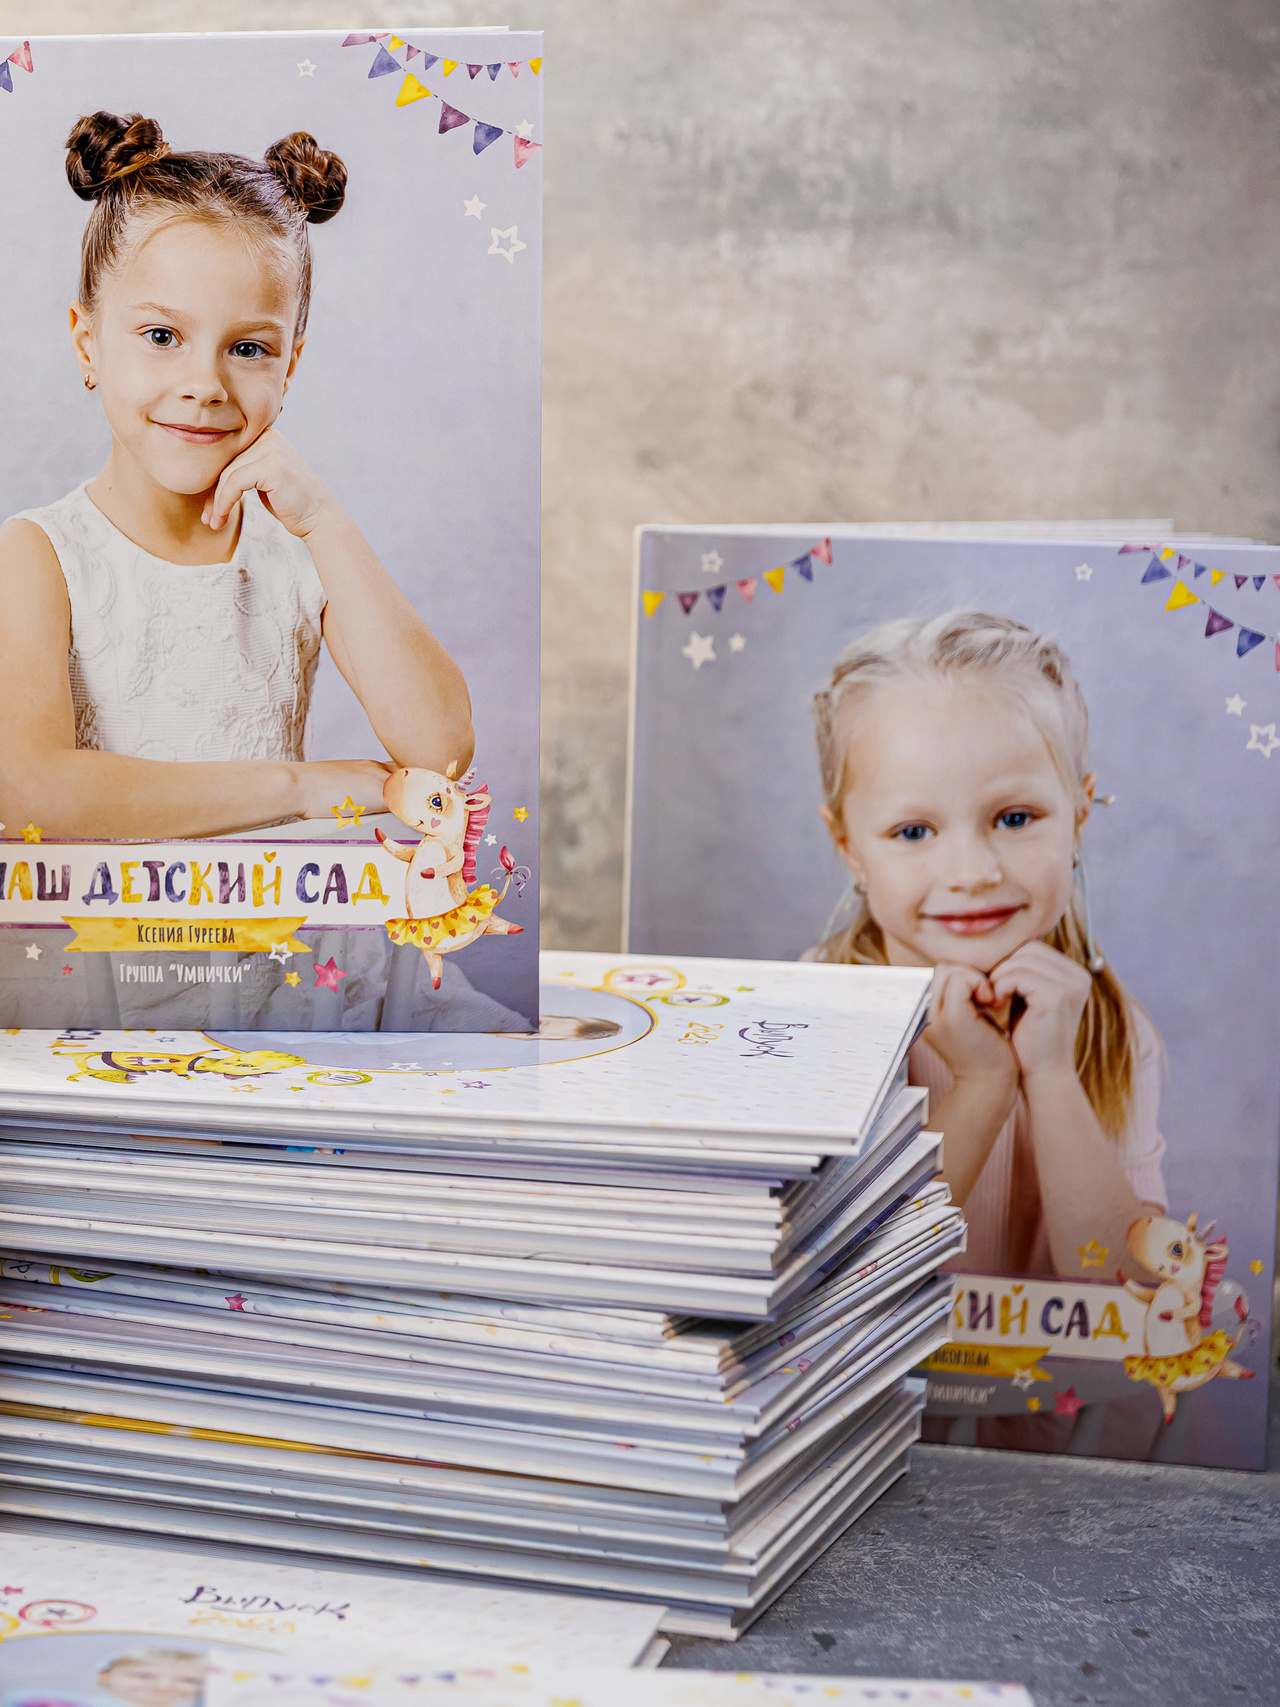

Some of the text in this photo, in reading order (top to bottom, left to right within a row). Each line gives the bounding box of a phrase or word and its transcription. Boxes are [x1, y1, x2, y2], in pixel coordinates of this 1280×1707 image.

[81, 851, 282, 907] ДЕТСКИЙ
[295, 861, 391, 907] САД
[1040, 1298, 1130, 1343] САД
